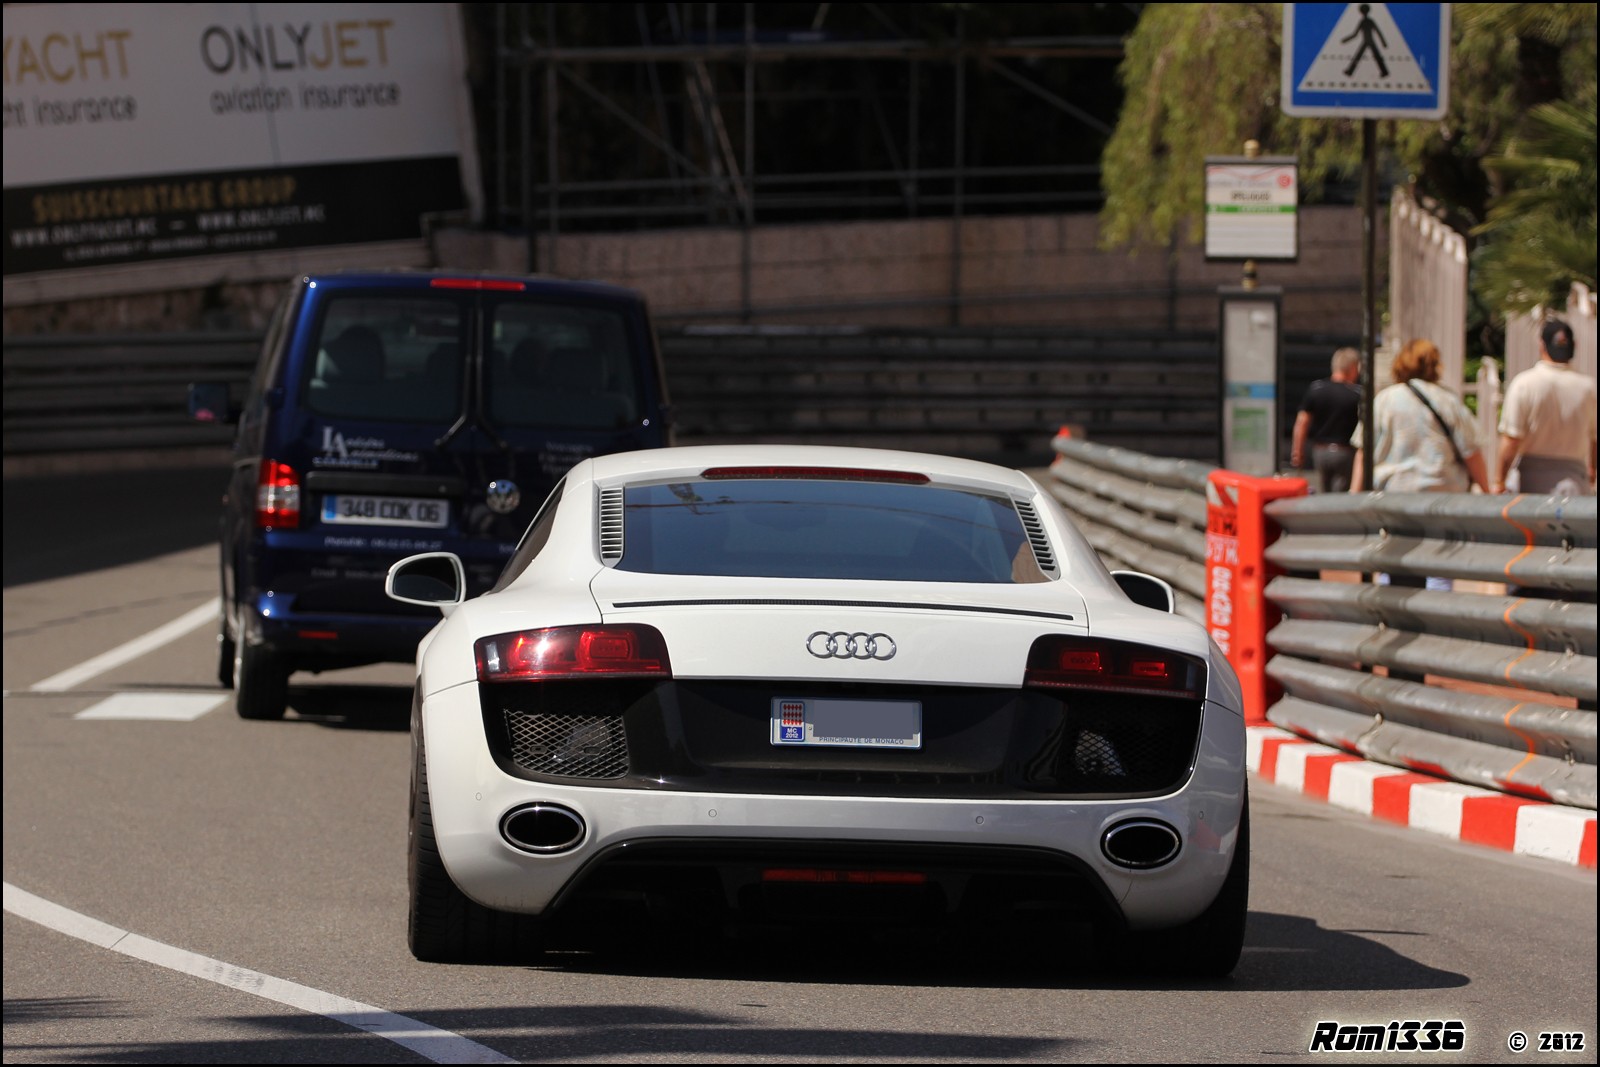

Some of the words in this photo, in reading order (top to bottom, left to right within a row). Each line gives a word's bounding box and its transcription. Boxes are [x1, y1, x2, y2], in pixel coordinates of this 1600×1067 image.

[201, 18, 395, 74] ONLYJET
[32, 95, 137, 127] insurance
[210, 84, 293, 115] aviation
[302, 81, 401, 110] insurance
[219, 174, 297, 208] GROUP
[342, 498, 375, 518] 348
[417, 502, 440, 523] 06
